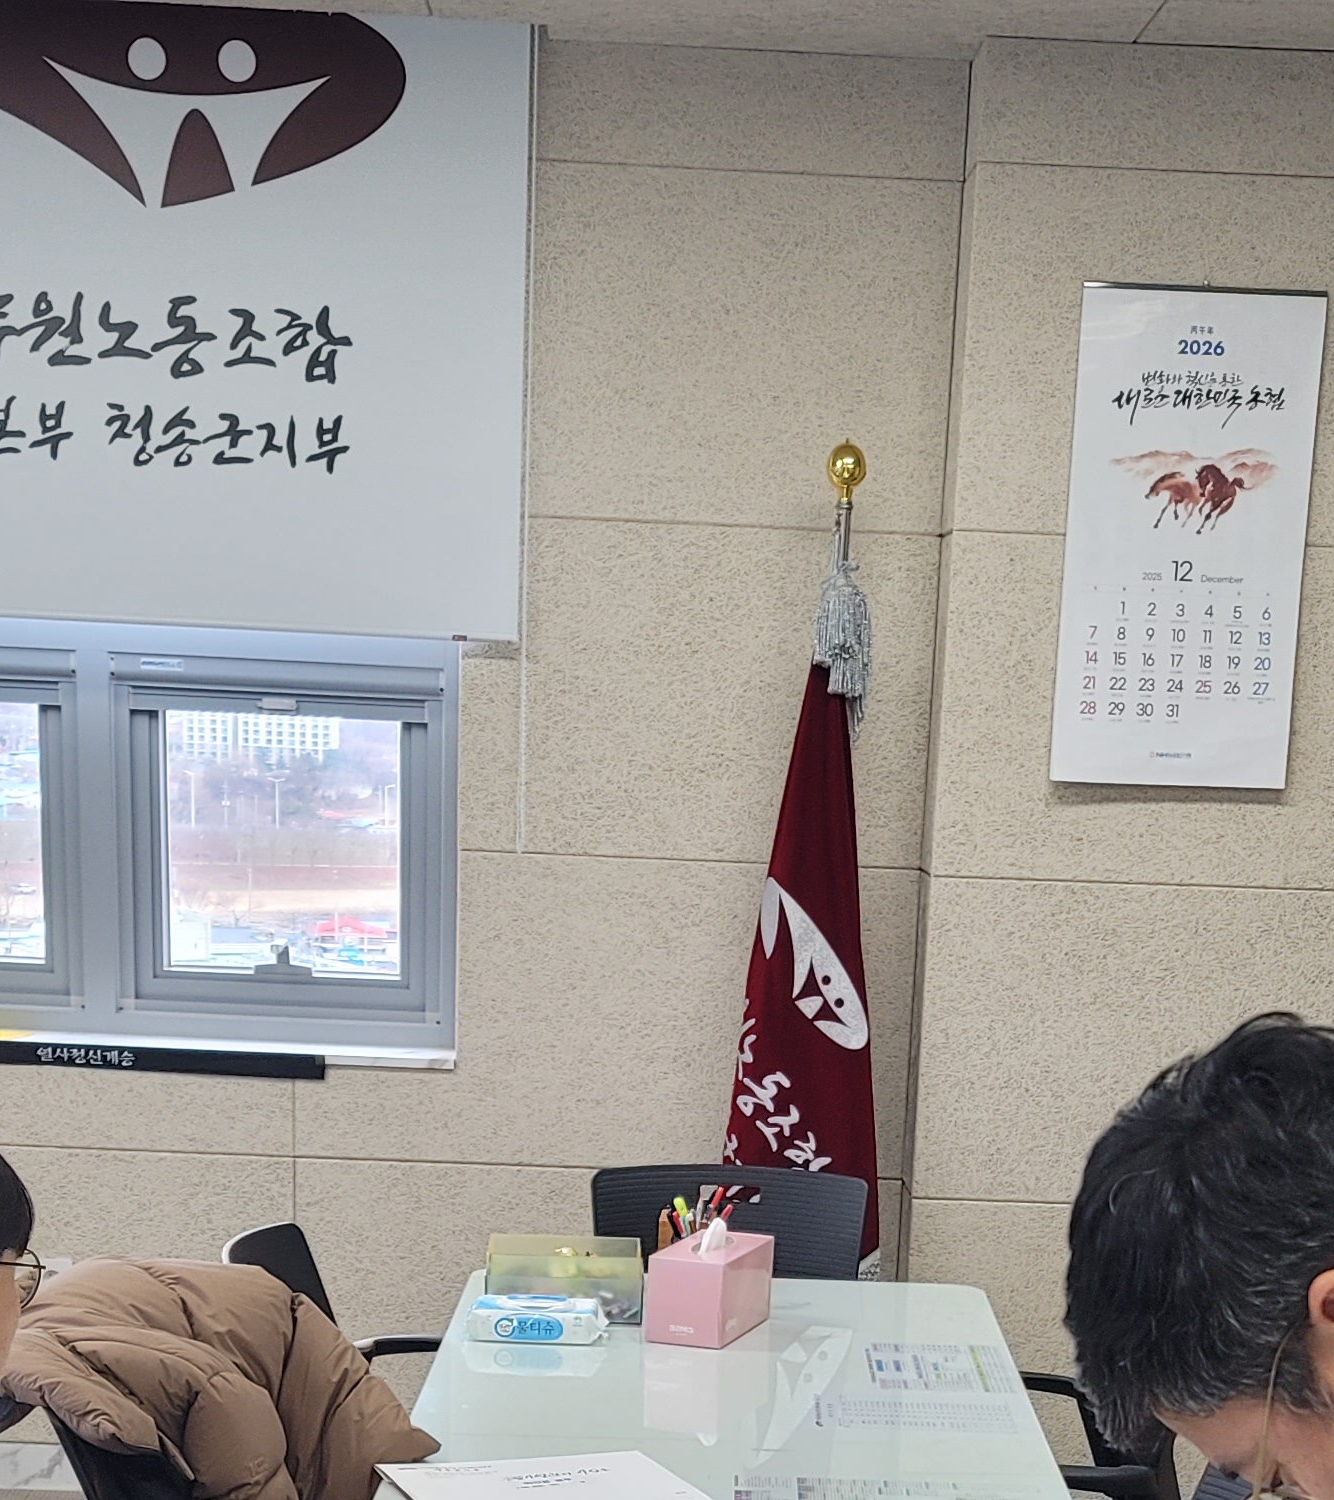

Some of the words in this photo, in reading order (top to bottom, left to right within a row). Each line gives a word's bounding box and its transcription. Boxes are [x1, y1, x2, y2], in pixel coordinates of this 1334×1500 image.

[1178, 339, 1225, 357] 2026
[1112, 385, 1171, 426] 새로운
[1173, 387, 1244, 429] 대한민국
[104, 401, 351, 475] 청송군지부
[1142, 572, 1163, 581] 2025
[1171, 560, 1194, 583] 12
[1200, 574, 1244, 585] December
[1120, 601, 1126, 615] 1
[1147, 602, 1157, 616] 2
[1175, 603, 1185, 617] 3
[1204, 605, 1214, 618] 4
[1233, 605, 1243, 619] 5
[1262, 607, 1271, 620] 6
[1089, 625, 1098, 639] 7
[1117, 626, 1126, 640] 8
[1146, 627, 1155, 642] 9
[1171, 629, 1186, 643] 10
[1202, 629, 1212, 643] 11
[1229, 631, 1242, 645] 12
[1258, 632, 1271, 646] 13
[1085, 651, 1098, 664] 14
[1113, 651, 1126, 666] 15
[1141, 653, 1155, 667] 16
[1170, 654, 1184, 668] 17
[1199, 655, 1212, 669] 18
[1227, 656, 1241, 670] 19
[1254, 657, 1271, 671] 20
[1082, 676, 1096, 690] 21
[1109, 676, 1127, 691] 22
[1138, 678, 1155, 692] 23
[1166, 678, 1184, 693] 24
[1195, 680, 1212, 694] 25
[1223, 681, 1241, 695] 26
[1252, 682, 1269, 696] 27
[1079, 701, 1097, 715] 28
[1108, 702, 1125, 716] 29
[1136, 703, 1154, 717] 30
[1166, 704, 1179, 718] 31
[36, 1045, 137, 1068] 열사정신계승
[517, 1320, 555, 1336] 물티슈
